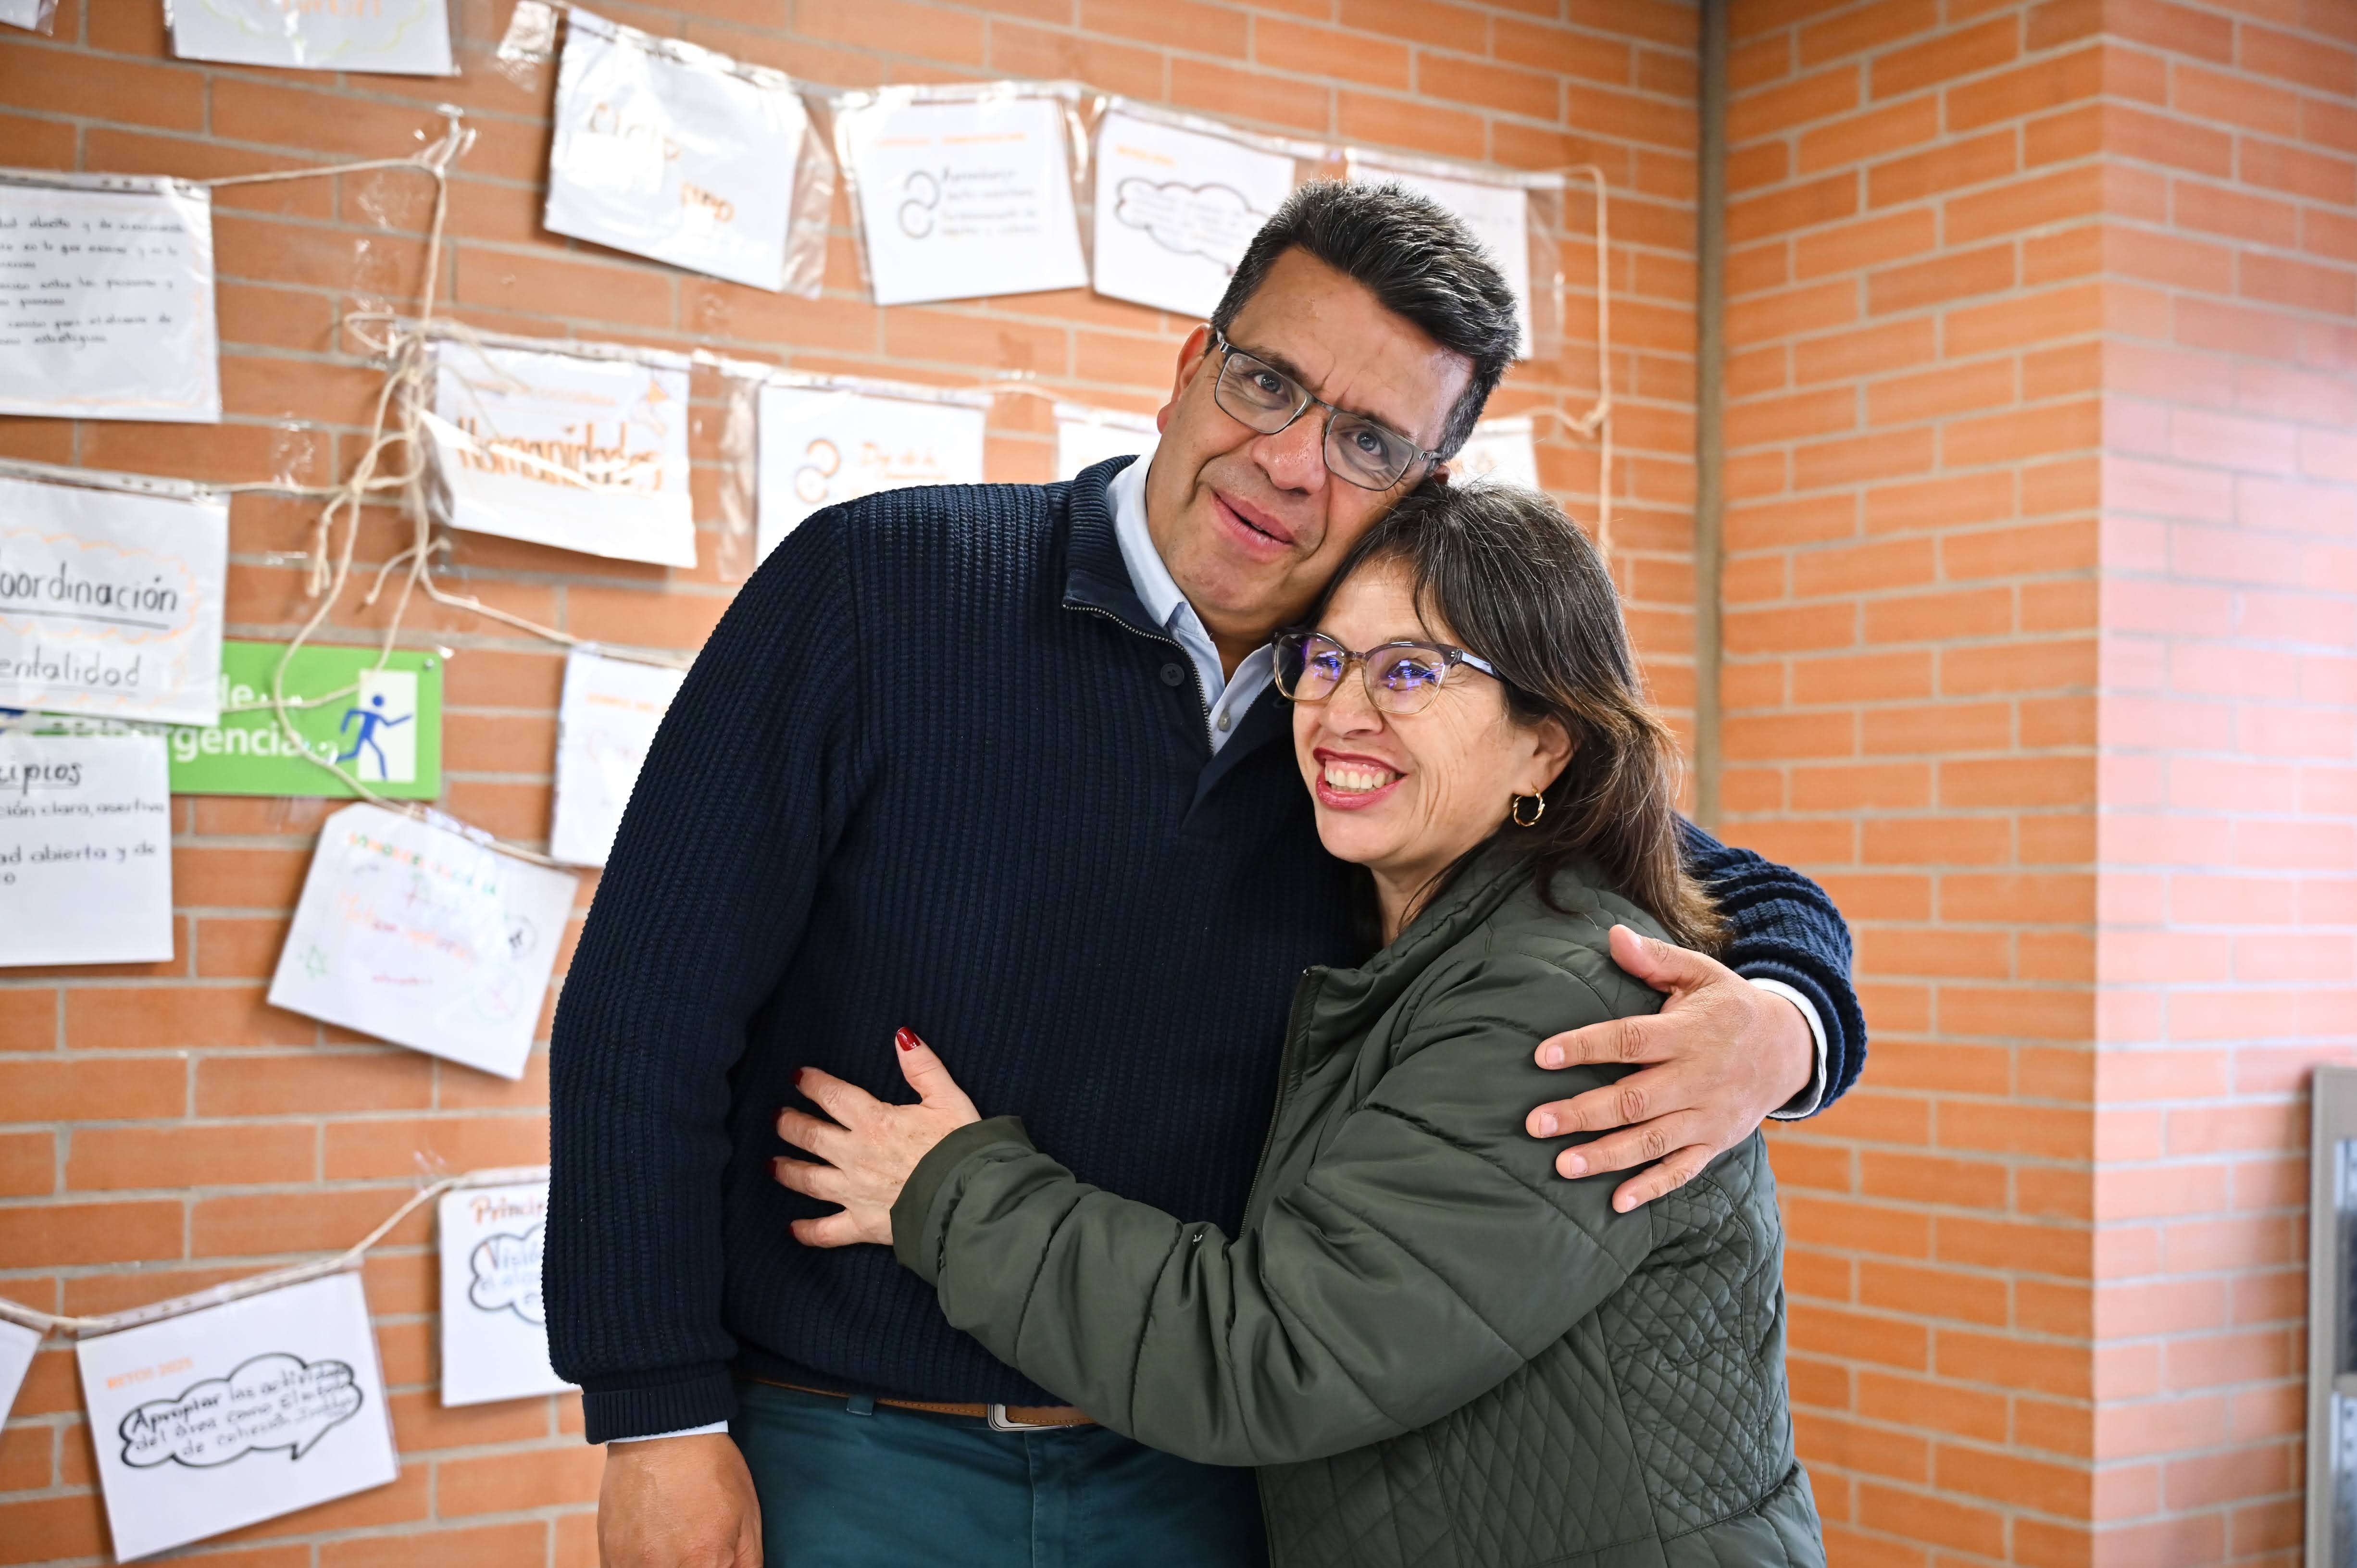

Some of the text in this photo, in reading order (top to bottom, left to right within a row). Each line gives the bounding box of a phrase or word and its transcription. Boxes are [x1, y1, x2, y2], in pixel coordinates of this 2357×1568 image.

[0, 560, 178, 612] oordinación
[31, 844, 107, 863] abierta
[117, 846, 126, 865] y
[131, 1391, 222, 1434] Apropiar
